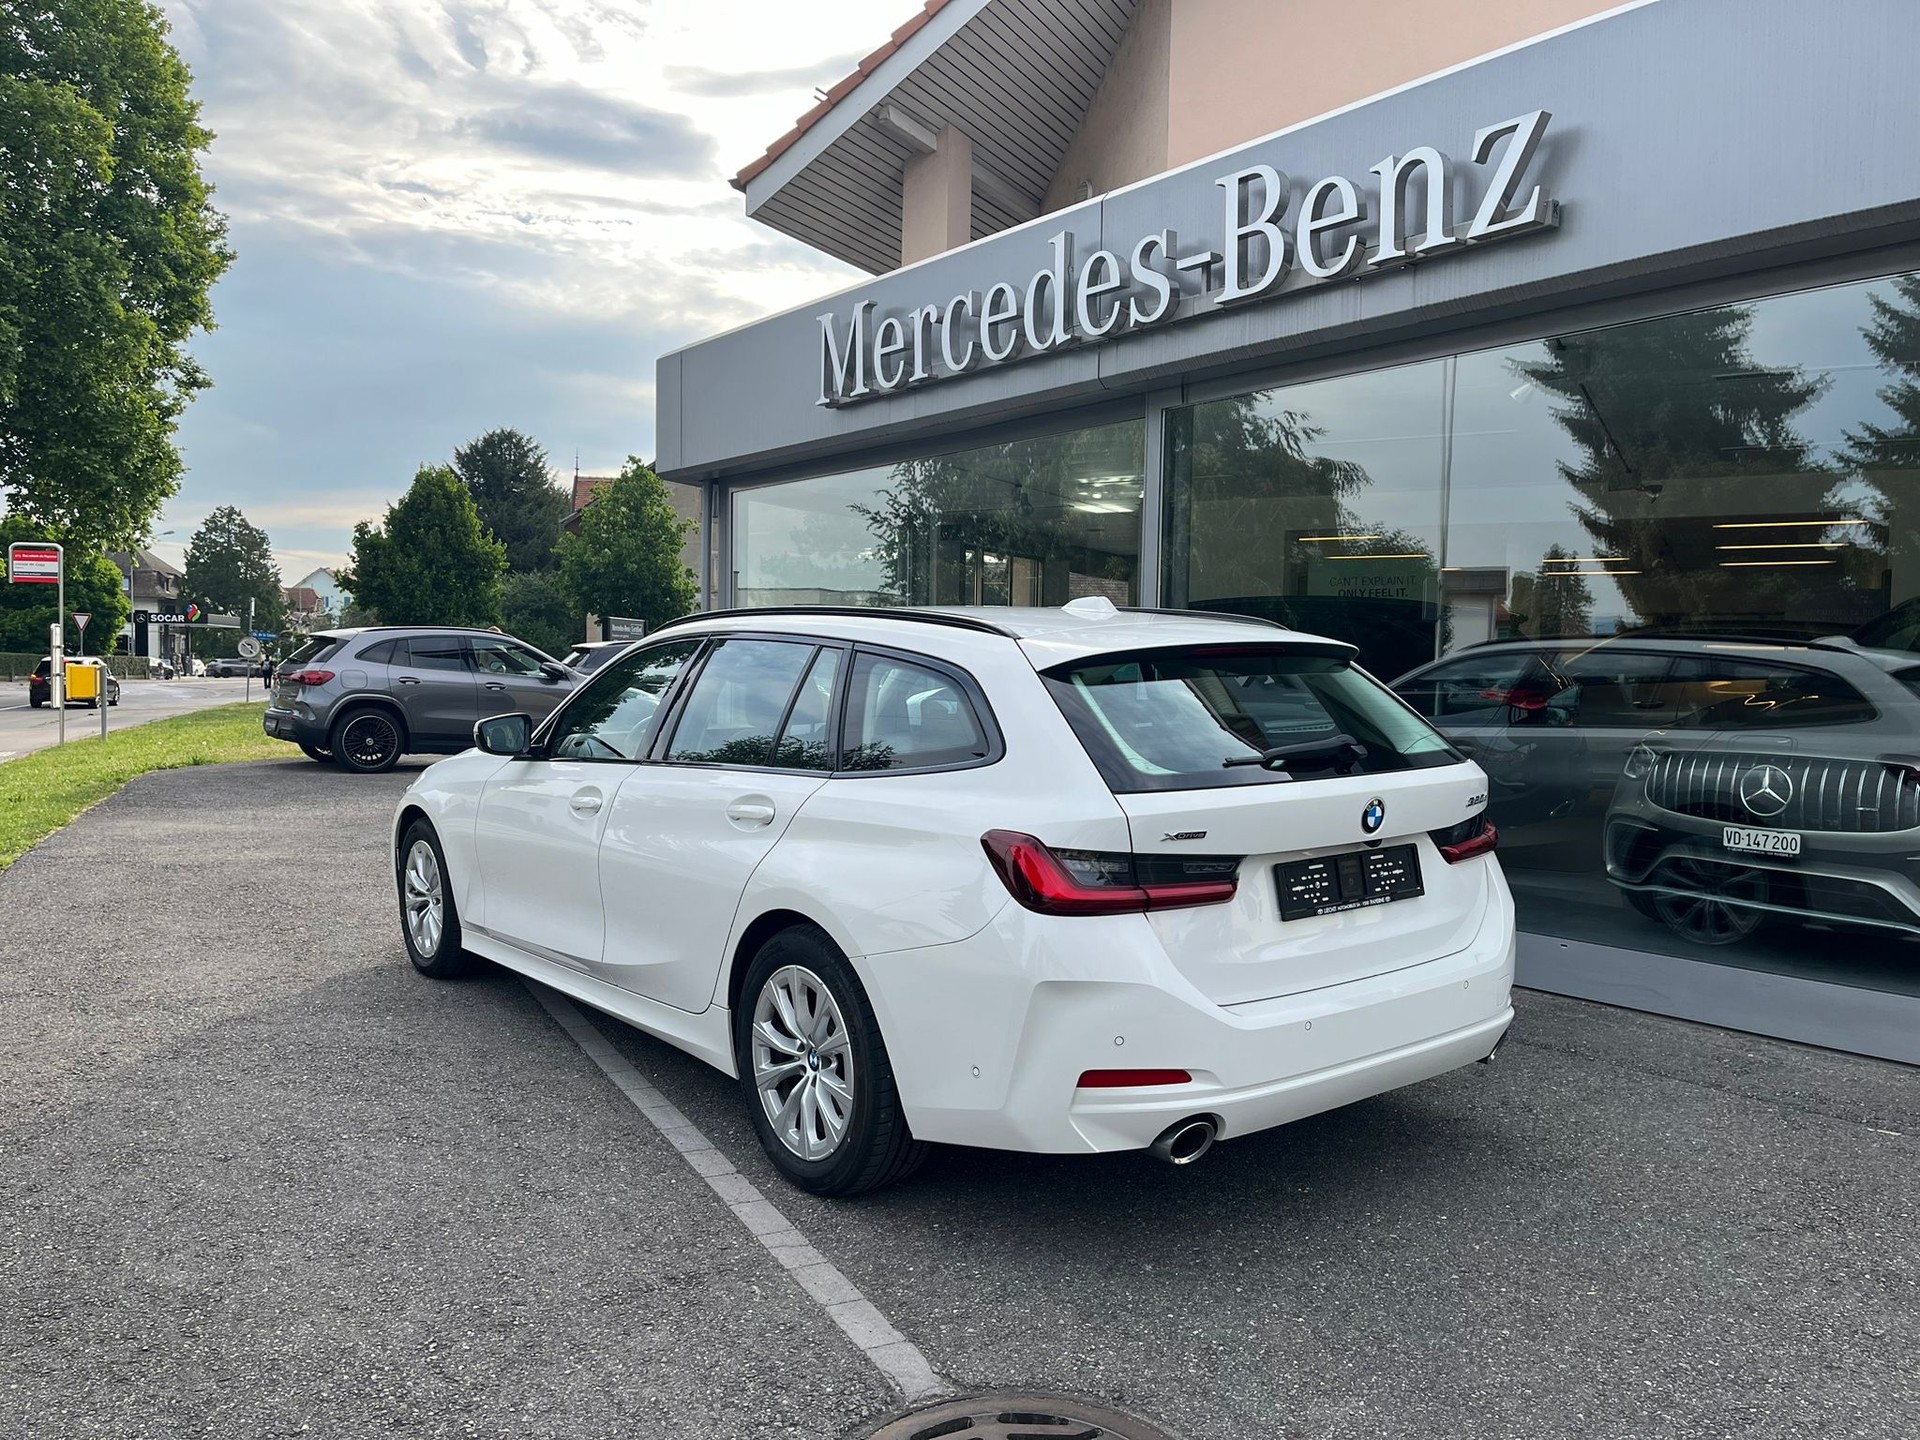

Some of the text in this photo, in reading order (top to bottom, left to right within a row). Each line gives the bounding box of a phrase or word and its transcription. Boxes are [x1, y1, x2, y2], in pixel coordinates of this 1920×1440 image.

[815, 109, 1555, 408] Mercedes-Benz
[1329, 576, 1357, 587] CAN'T
[1361, 576, 1403, 587] EXPLAIN
[1338, 588, 1408, 598] ONLY FEEL IT.
[150, 614, 185, 623] SOCAR
